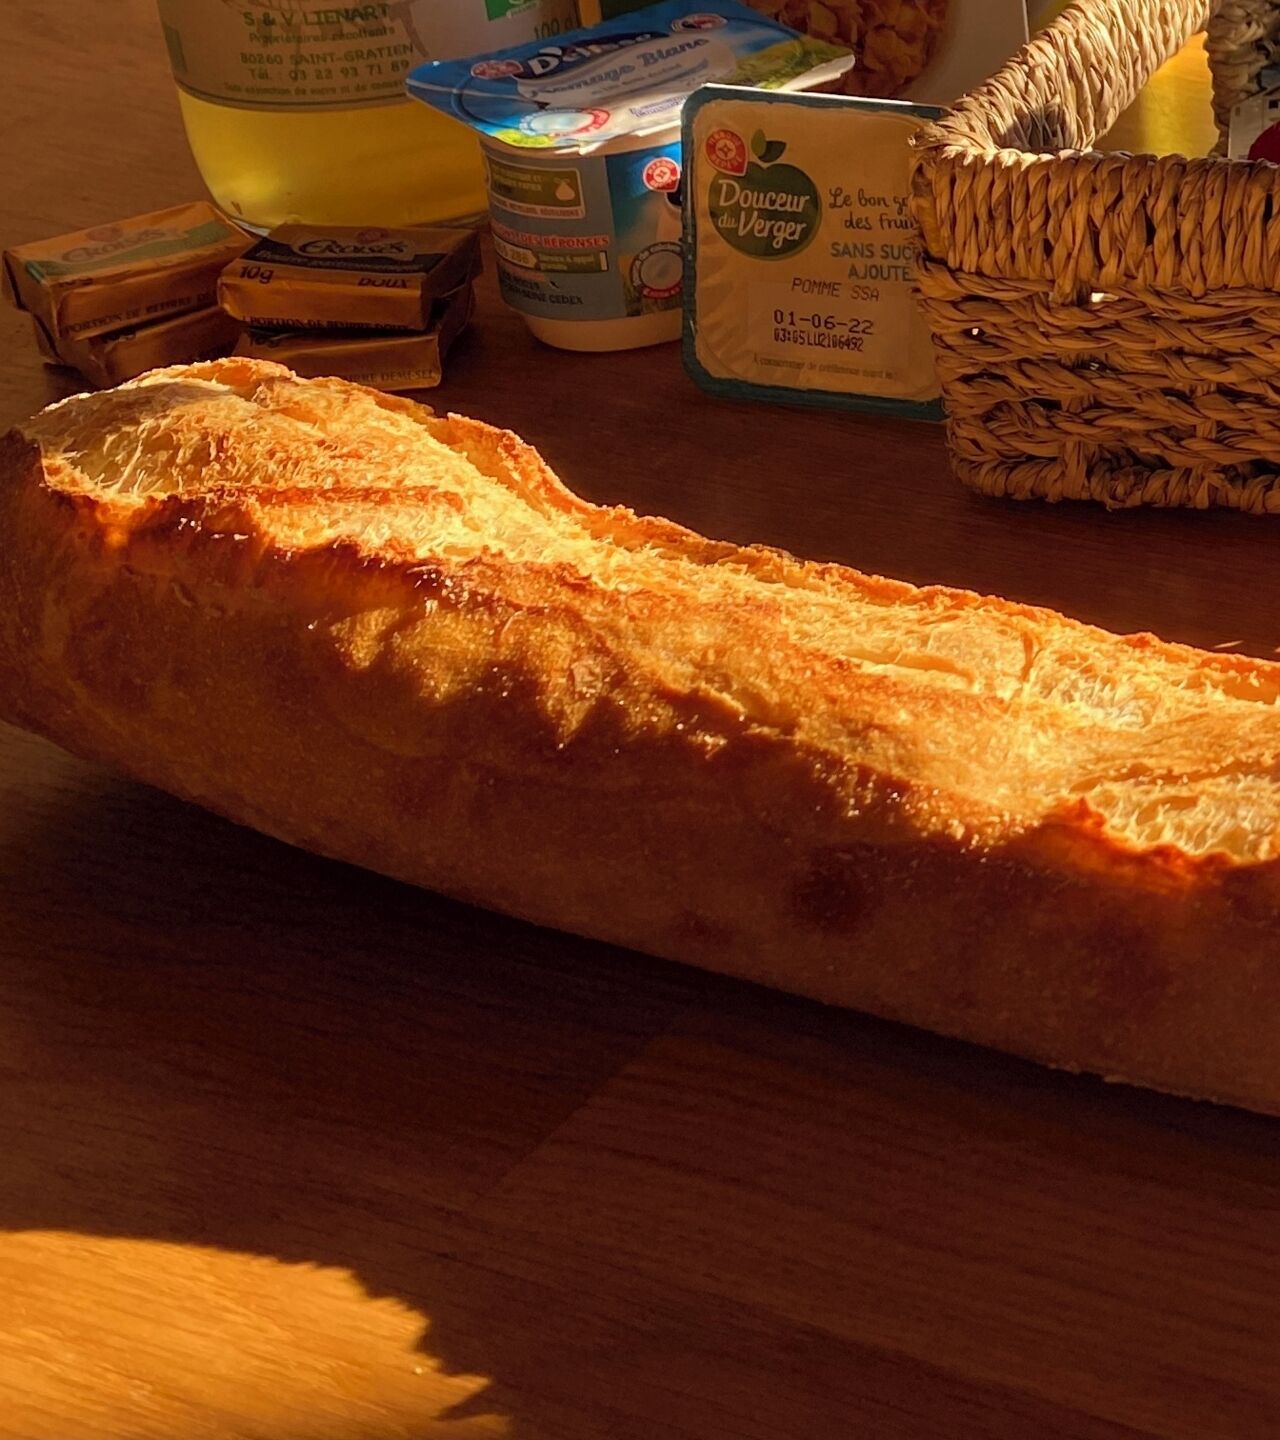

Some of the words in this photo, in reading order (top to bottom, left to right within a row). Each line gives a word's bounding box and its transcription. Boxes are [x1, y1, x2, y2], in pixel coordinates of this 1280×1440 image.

[243, 12, 256, 26] S
[262, 11, 276, 27] &
[281, 12, 294, 27] V
[303, 3, 390, 26] LIENART
[290, 43, 413, 66] SAINT-GRATIEN
[718, 179, 810, 212] Douceur
[829, 187, 852, 208] Le
[858, 188, 889, 208] bon
[893, 195, 908, 215] go
[718, 213, 737, 228] du
[737, 211, 807, 248] Verger
[844, 211, 872, 230] des
[543, 234, 609, 248] RÉPONSES
[831, 242, 874, 259] SANS
[239, 265, 274, 284] 10g
[791, 277, 842, 297] POMME
[850, 285, 880, 302] SSA
[773, 309, 874, 335] 01-06-22
